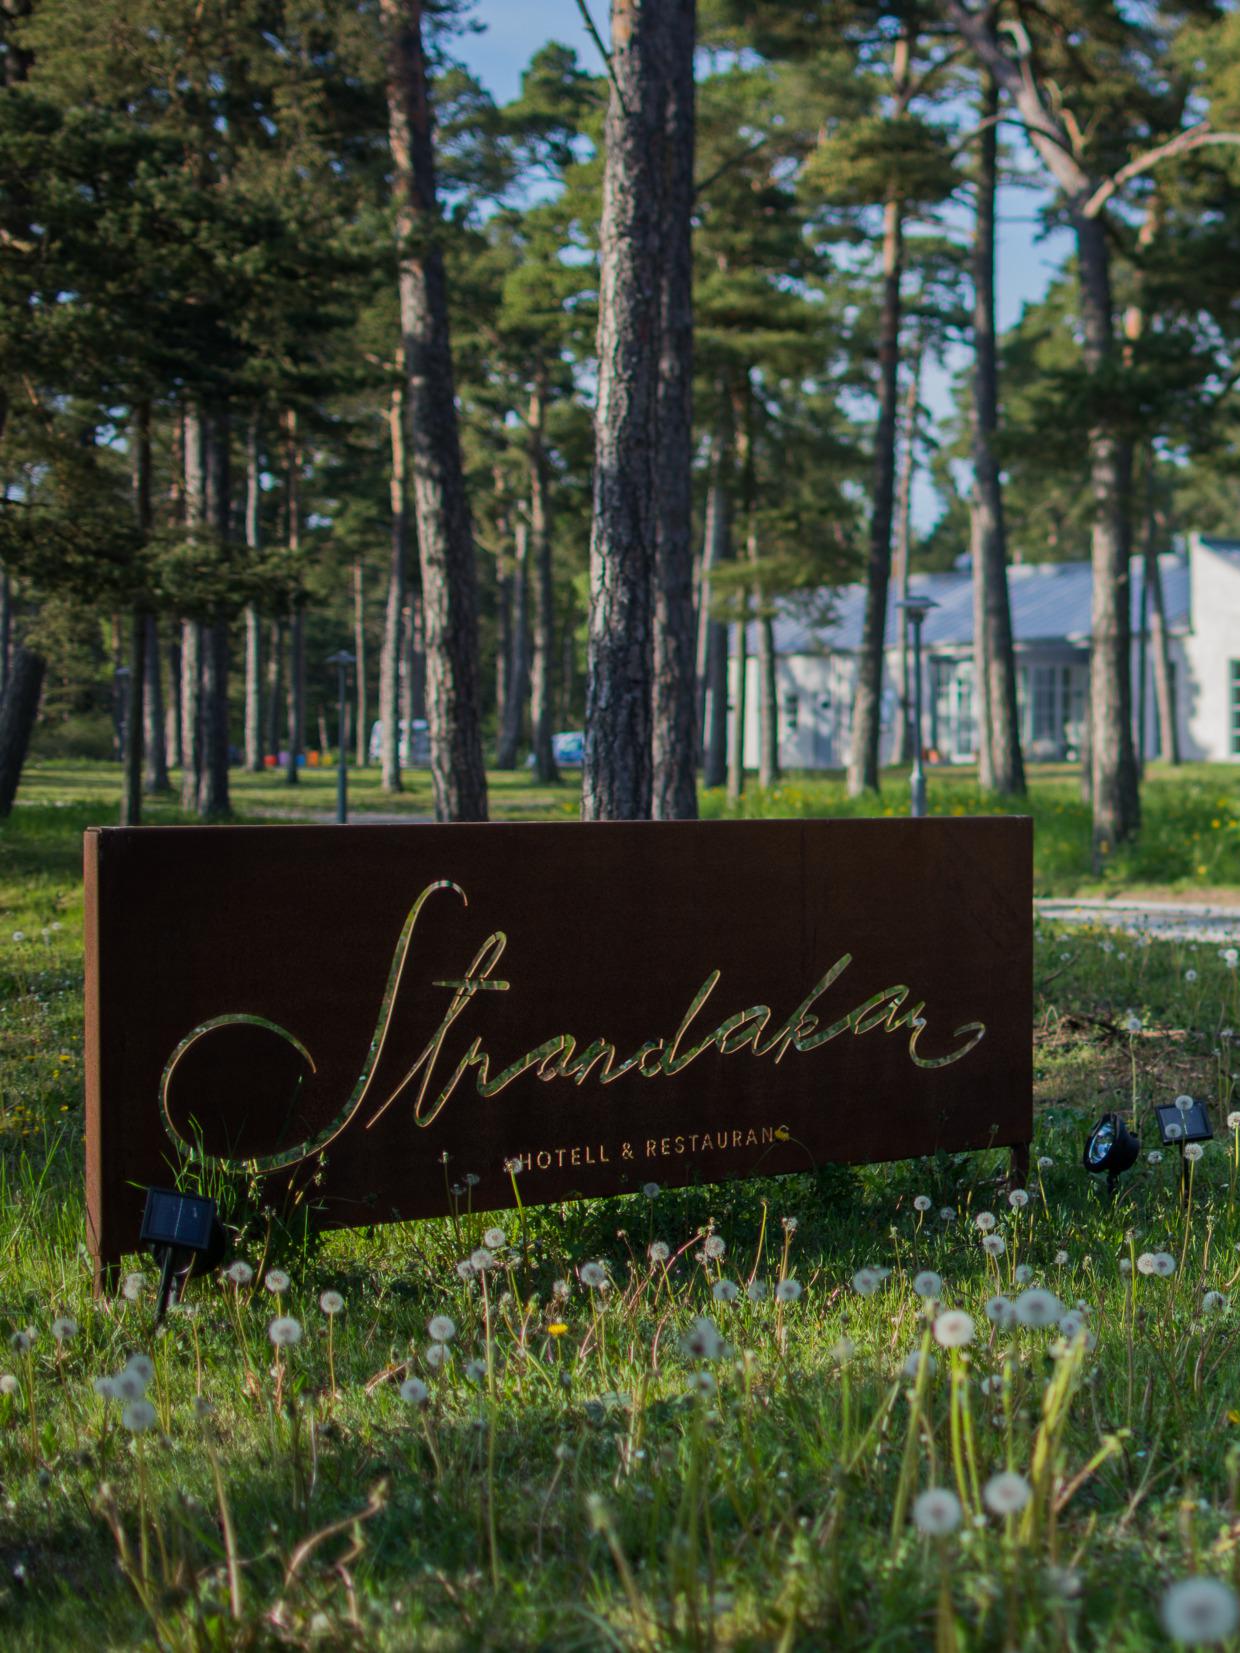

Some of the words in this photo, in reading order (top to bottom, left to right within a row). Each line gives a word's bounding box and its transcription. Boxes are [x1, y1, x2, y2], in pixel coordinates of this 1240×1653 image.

[158, 879, 986, 1174] Strandakar
[519, 1145, 609, 1171] HOTELL
[622, 1142, 635, 1160] &
